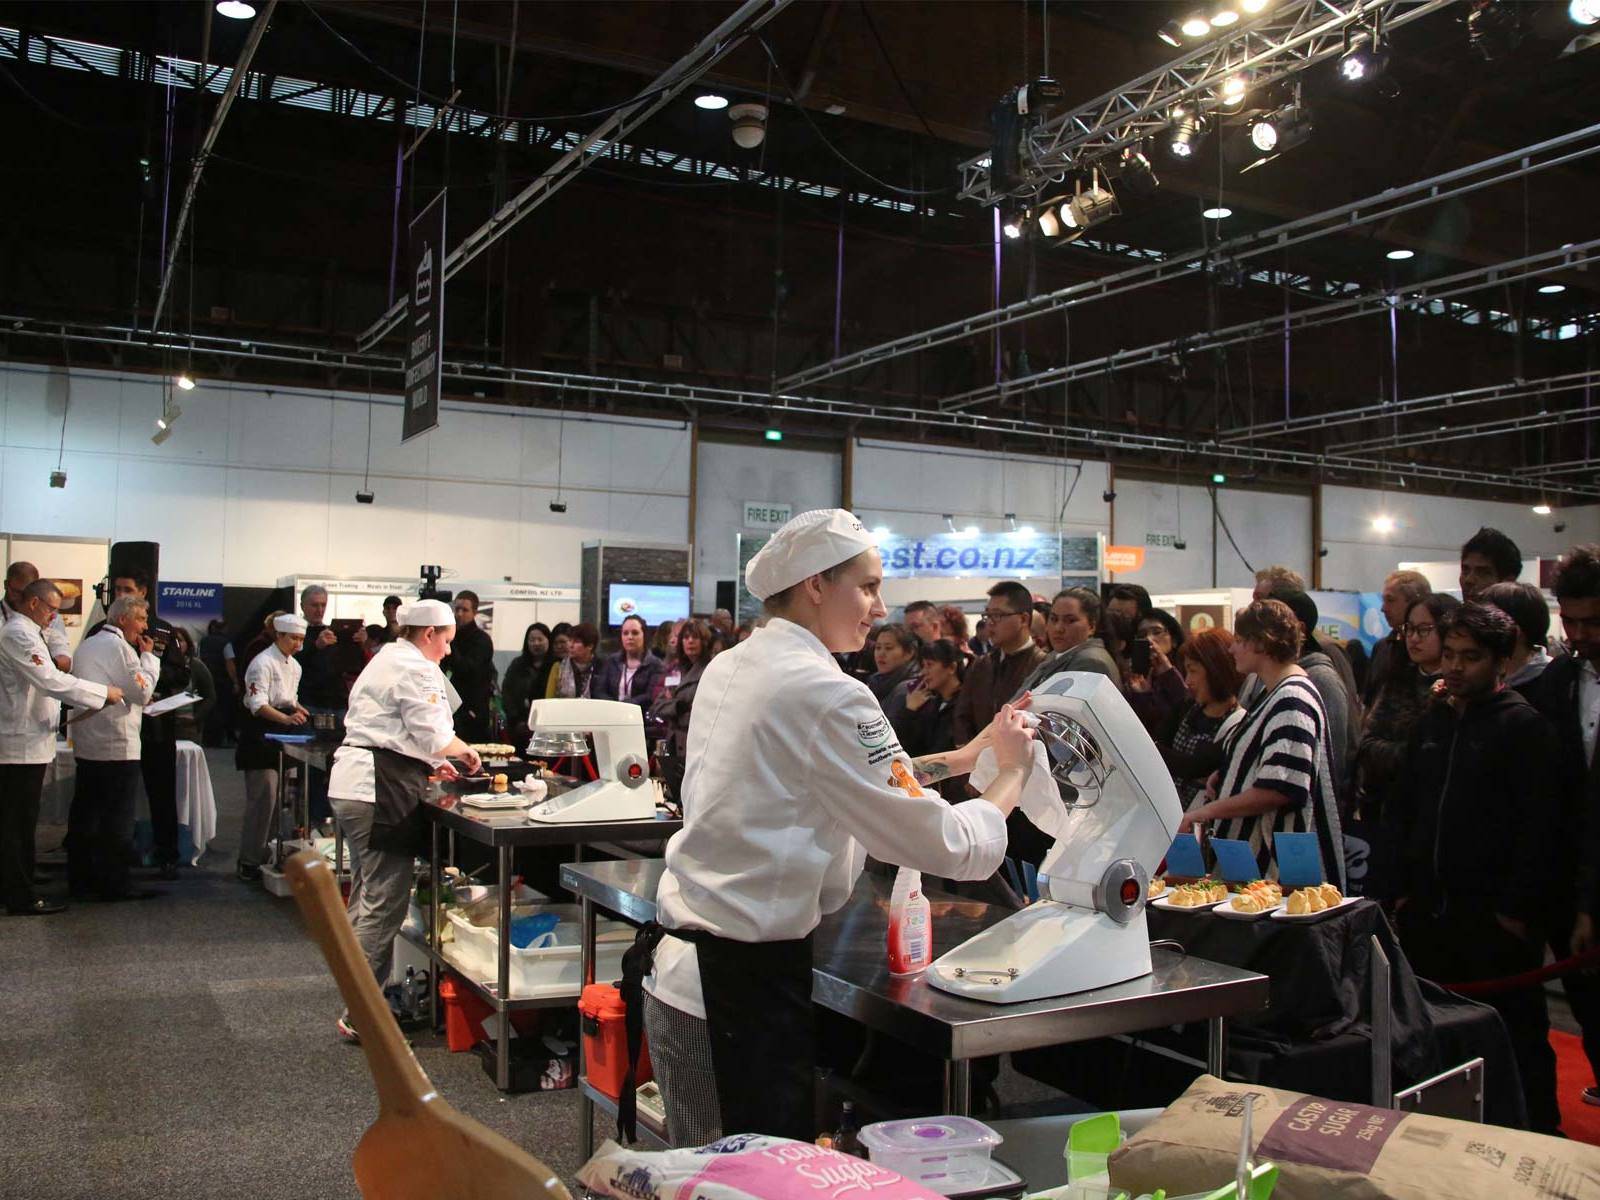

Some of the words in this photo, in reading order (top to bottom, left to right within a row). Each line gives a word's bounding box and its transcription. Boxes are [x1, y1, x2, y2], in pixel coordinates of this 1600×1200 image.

[748, 507, 767, 521] FIRE
[770, 509, 789, 523] EXIT
[1146, 533, 1161, 546] FIRE
[162, 587, 216, 597] STARLINE
[1318, 1108, 1360, 1136] SUGAR
[796, 1160, 888, 1191] Sugar
